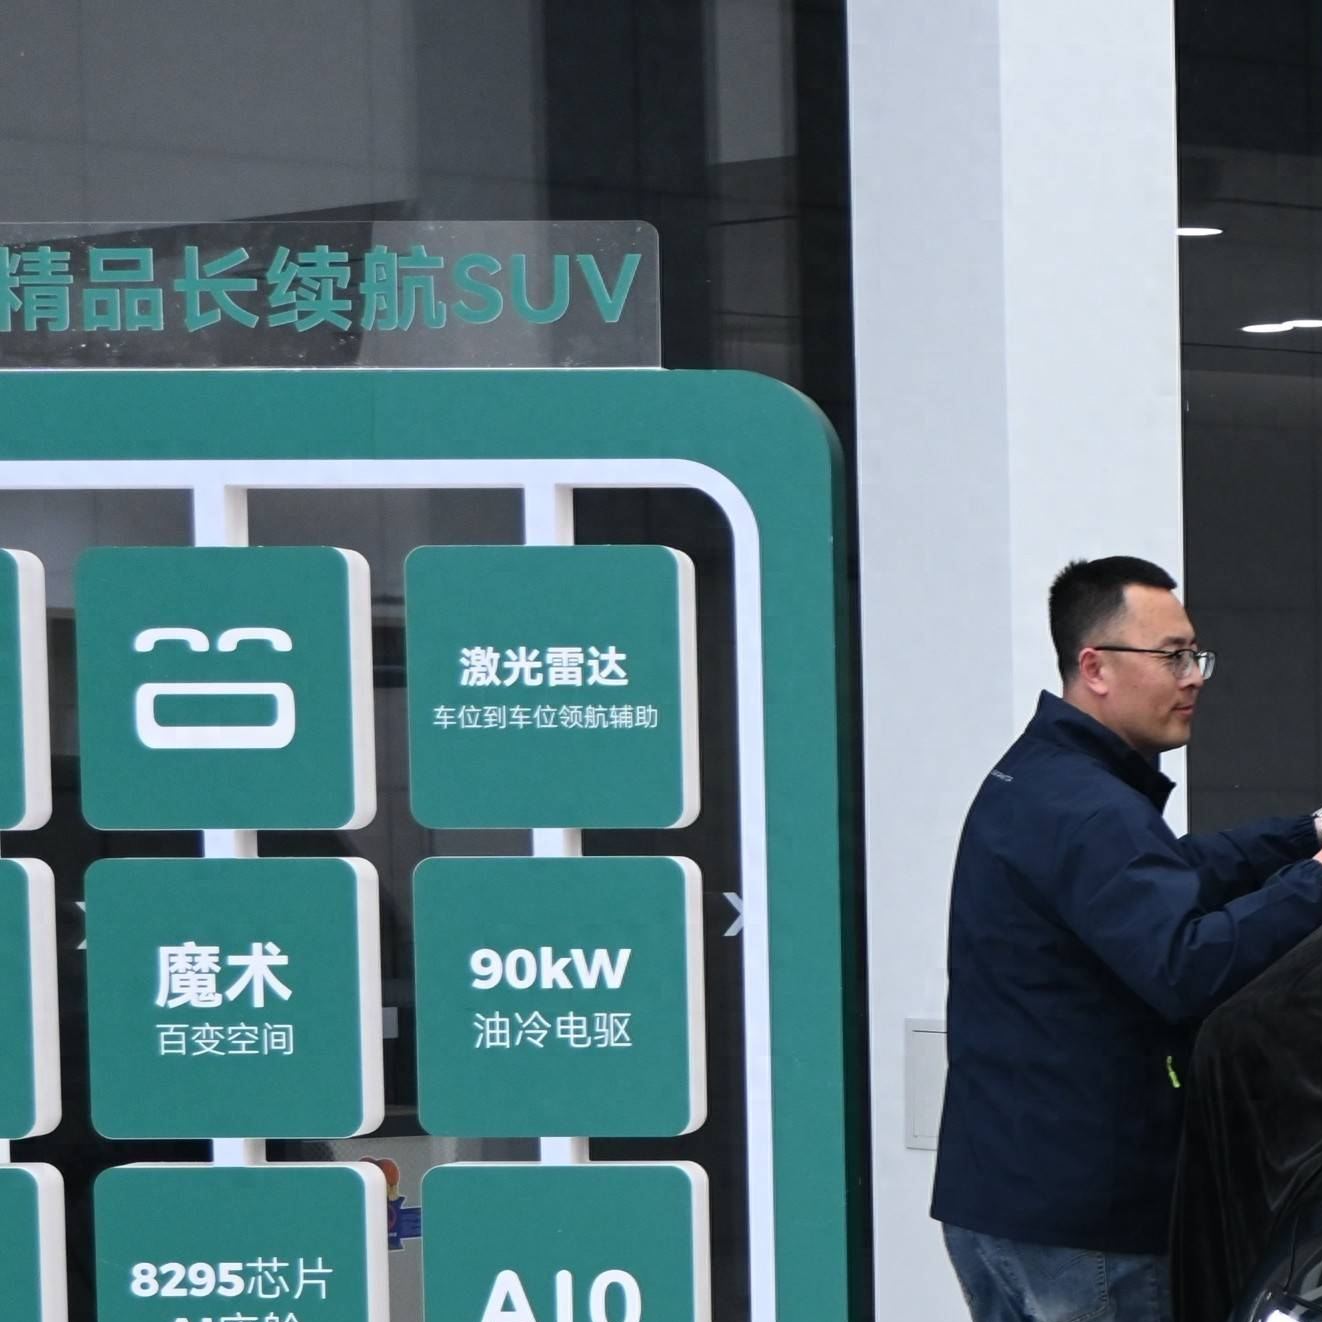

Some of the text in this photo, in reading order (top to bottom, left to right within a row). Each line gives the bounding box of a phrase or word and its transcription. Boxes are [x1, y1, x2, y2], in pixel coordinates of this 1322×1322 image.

[0, 245, 641, 332] 精品长续航SUV
[459, 645, 629, 688] 激光雷达
[433, 703, 658, 729] 车位到车位领航辅助
[155, 941, 293, 1008] 魔术
[470, 947, 632, 990] 90kW
[155, 1022, 295, 1056] 百变空间
[473, 1010, 633, 1049] 油冷电驱
[130, 1256, 333, 1300] 8295芯片
